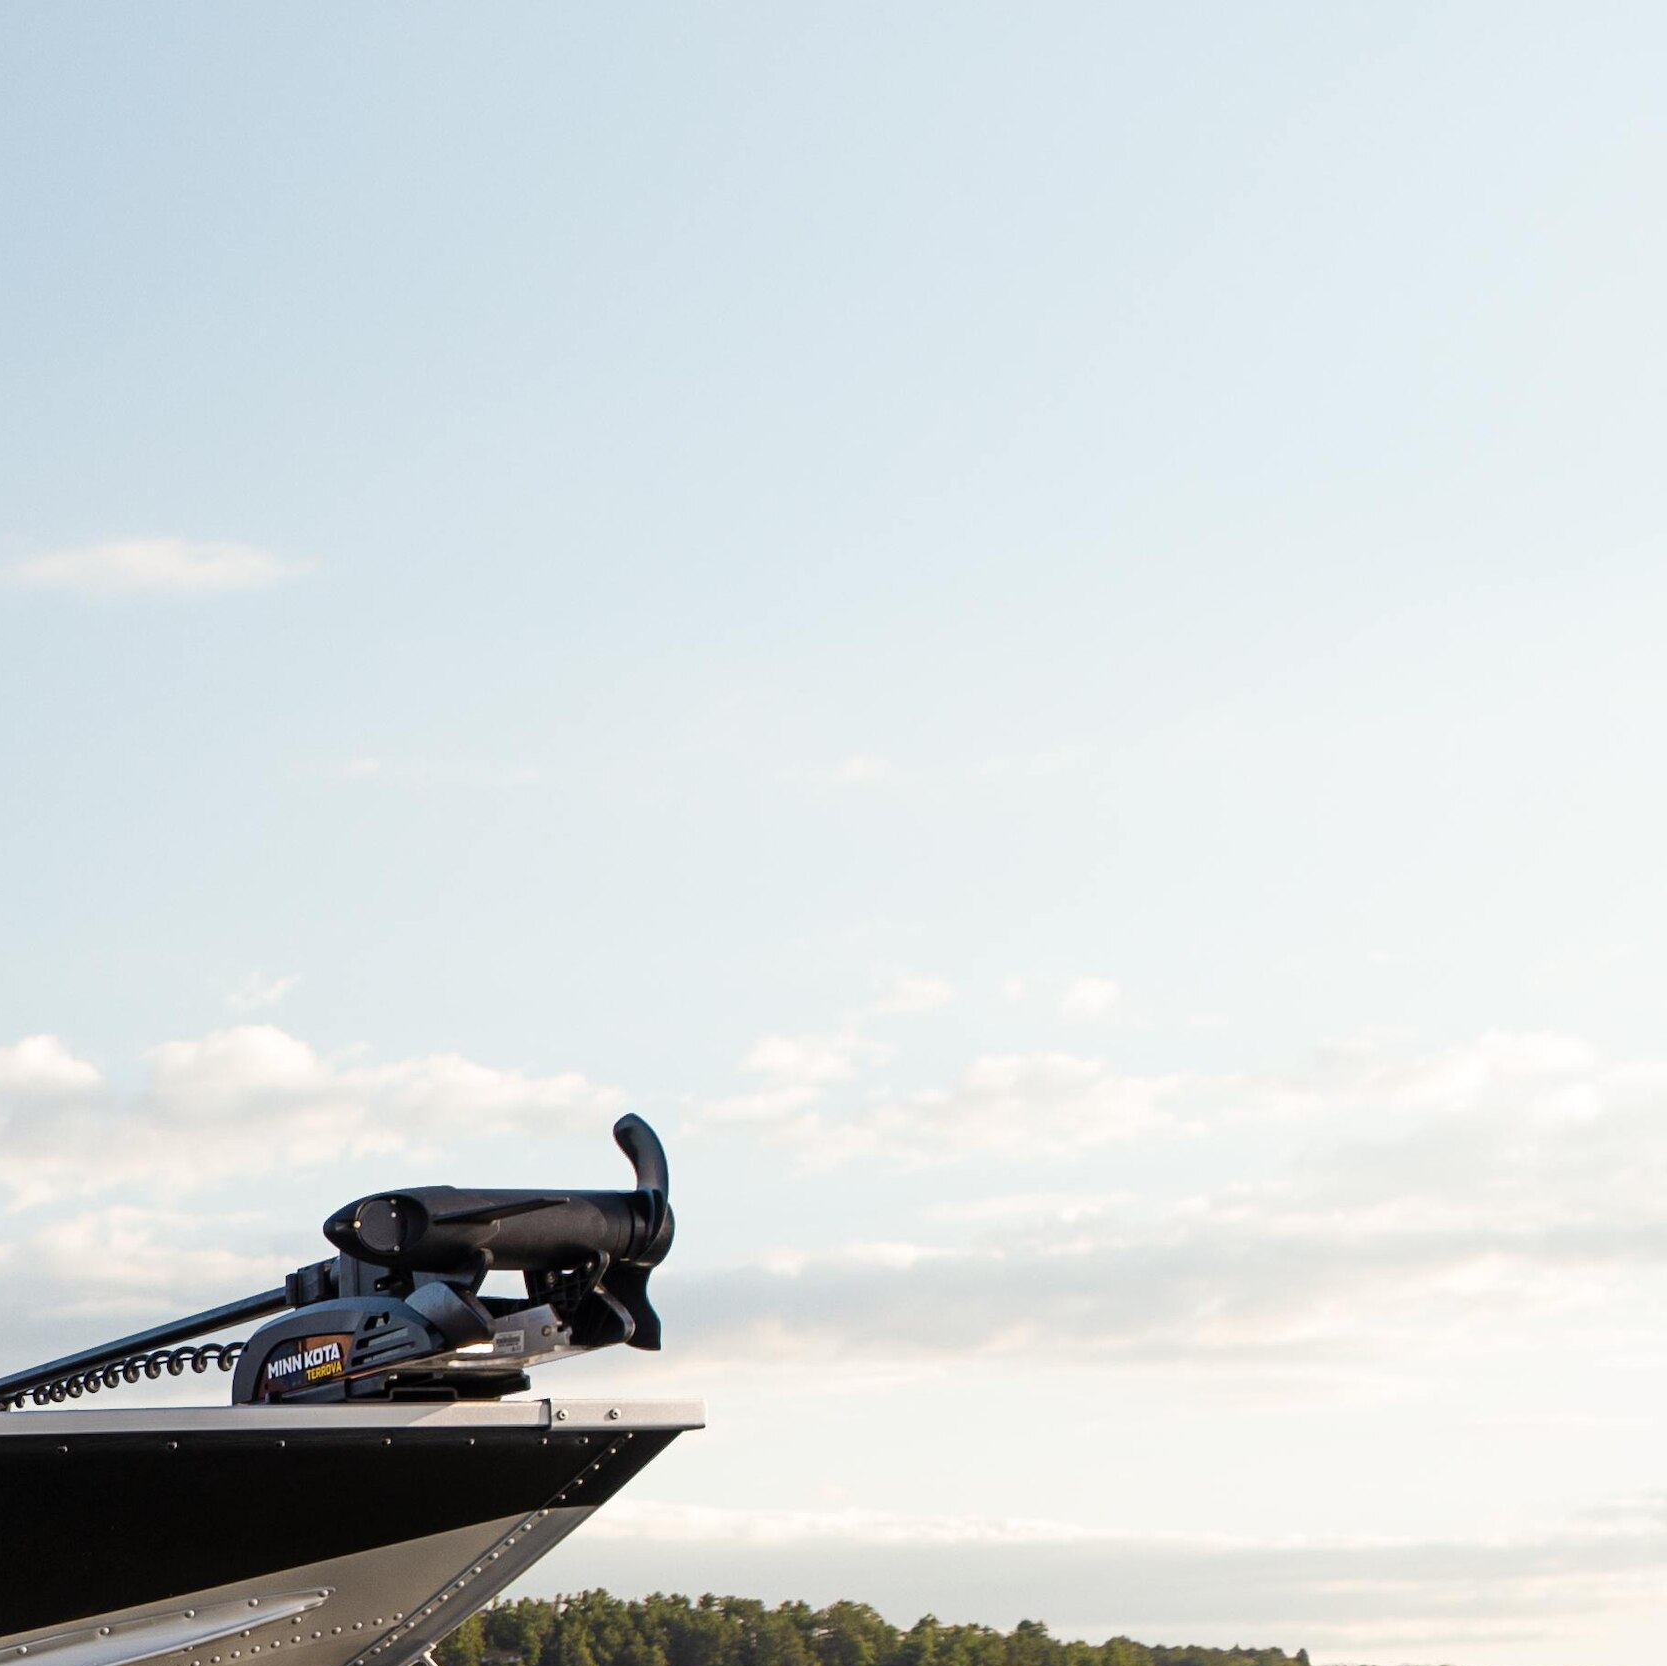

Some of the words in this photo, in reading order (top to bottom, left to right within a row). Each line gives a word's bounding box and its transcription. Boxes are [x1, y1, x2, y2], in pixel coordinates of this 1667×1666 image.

[268, 1354, 302, 1379] MINN
[303, 1343, 340, 1368] KOTA
[307, 1361, 342, 1380] TERROVA
